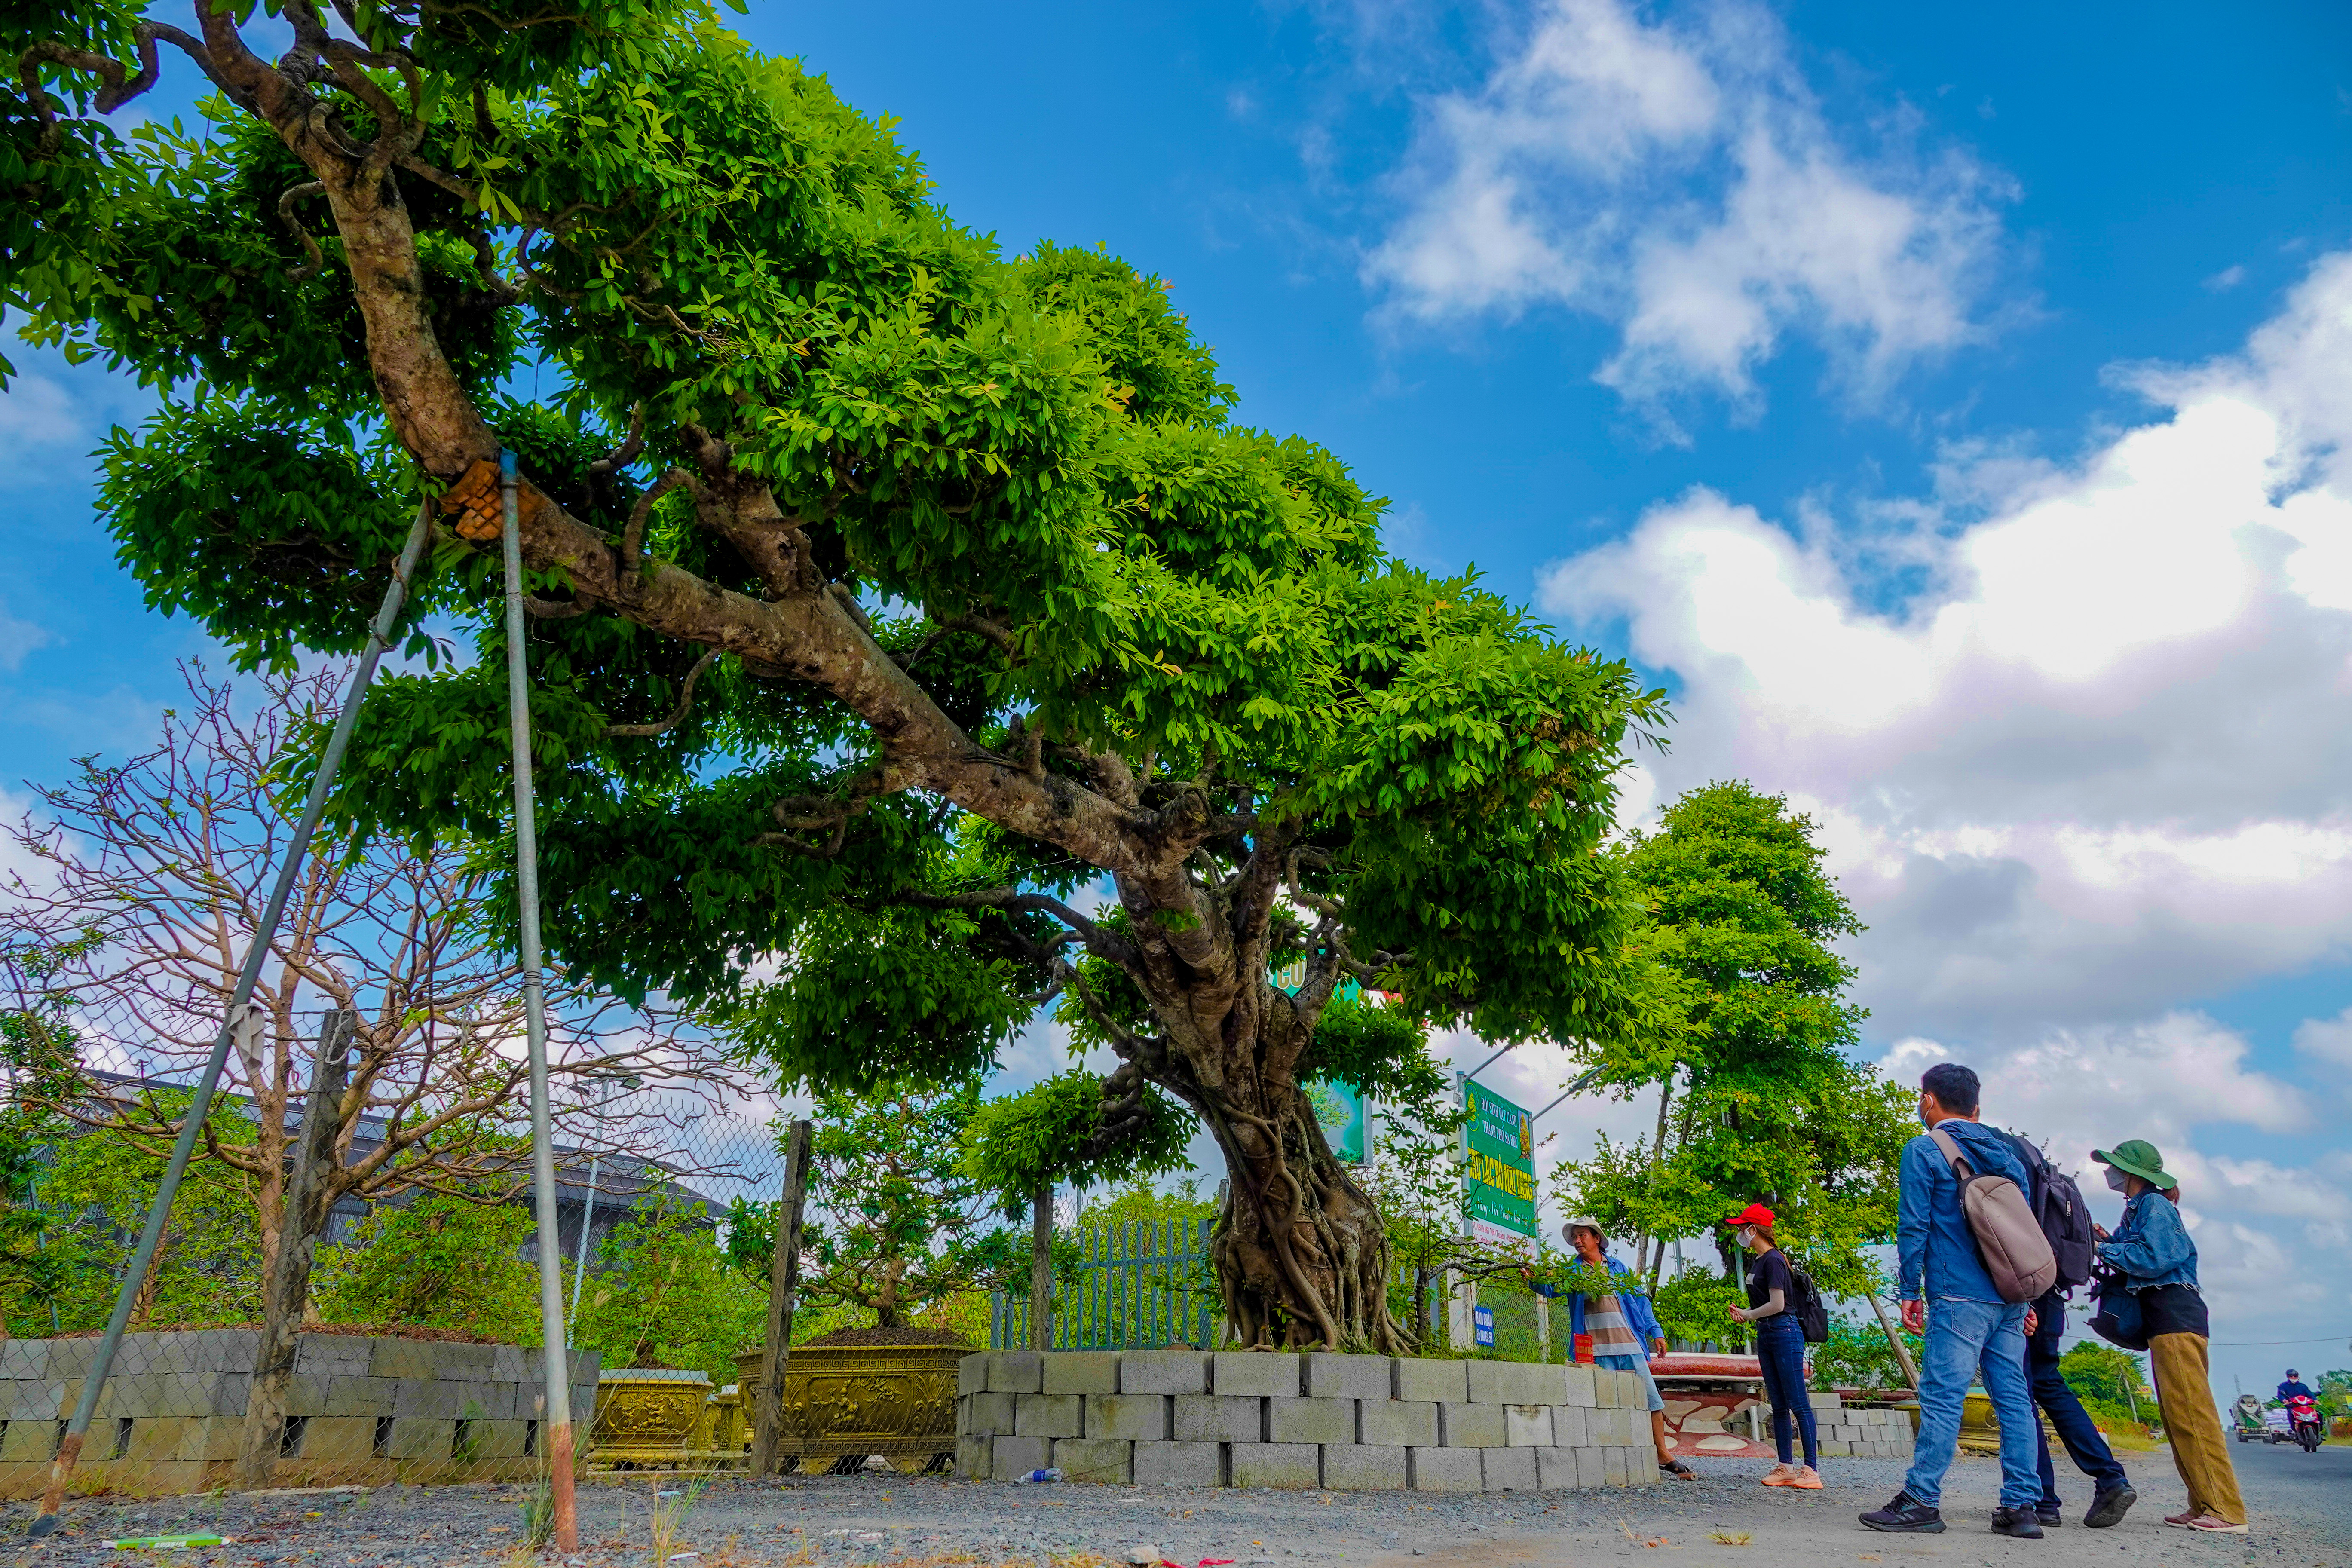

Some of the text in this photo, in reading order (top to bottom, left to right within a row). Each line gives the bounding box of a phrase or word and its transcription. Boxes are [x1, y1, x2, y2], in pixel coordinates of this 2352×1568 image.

[1481, 1095, 1489, 1115] HỘI
[1489, 1101, 1498, 1118] SINH
[1506, 1108, 1517, 1128] CẢNH
[1482, 1118, 1519, 1149] THÀNH PHỐ SA ĐÉC
[1482, 1154, 1495, 1192] LẠC
[1494, 1153, 1504, 1198] BỘ
[1503, 1163, 1517, 1196] MAI
[1516, 1162, 1533, 1202] VÀNG
